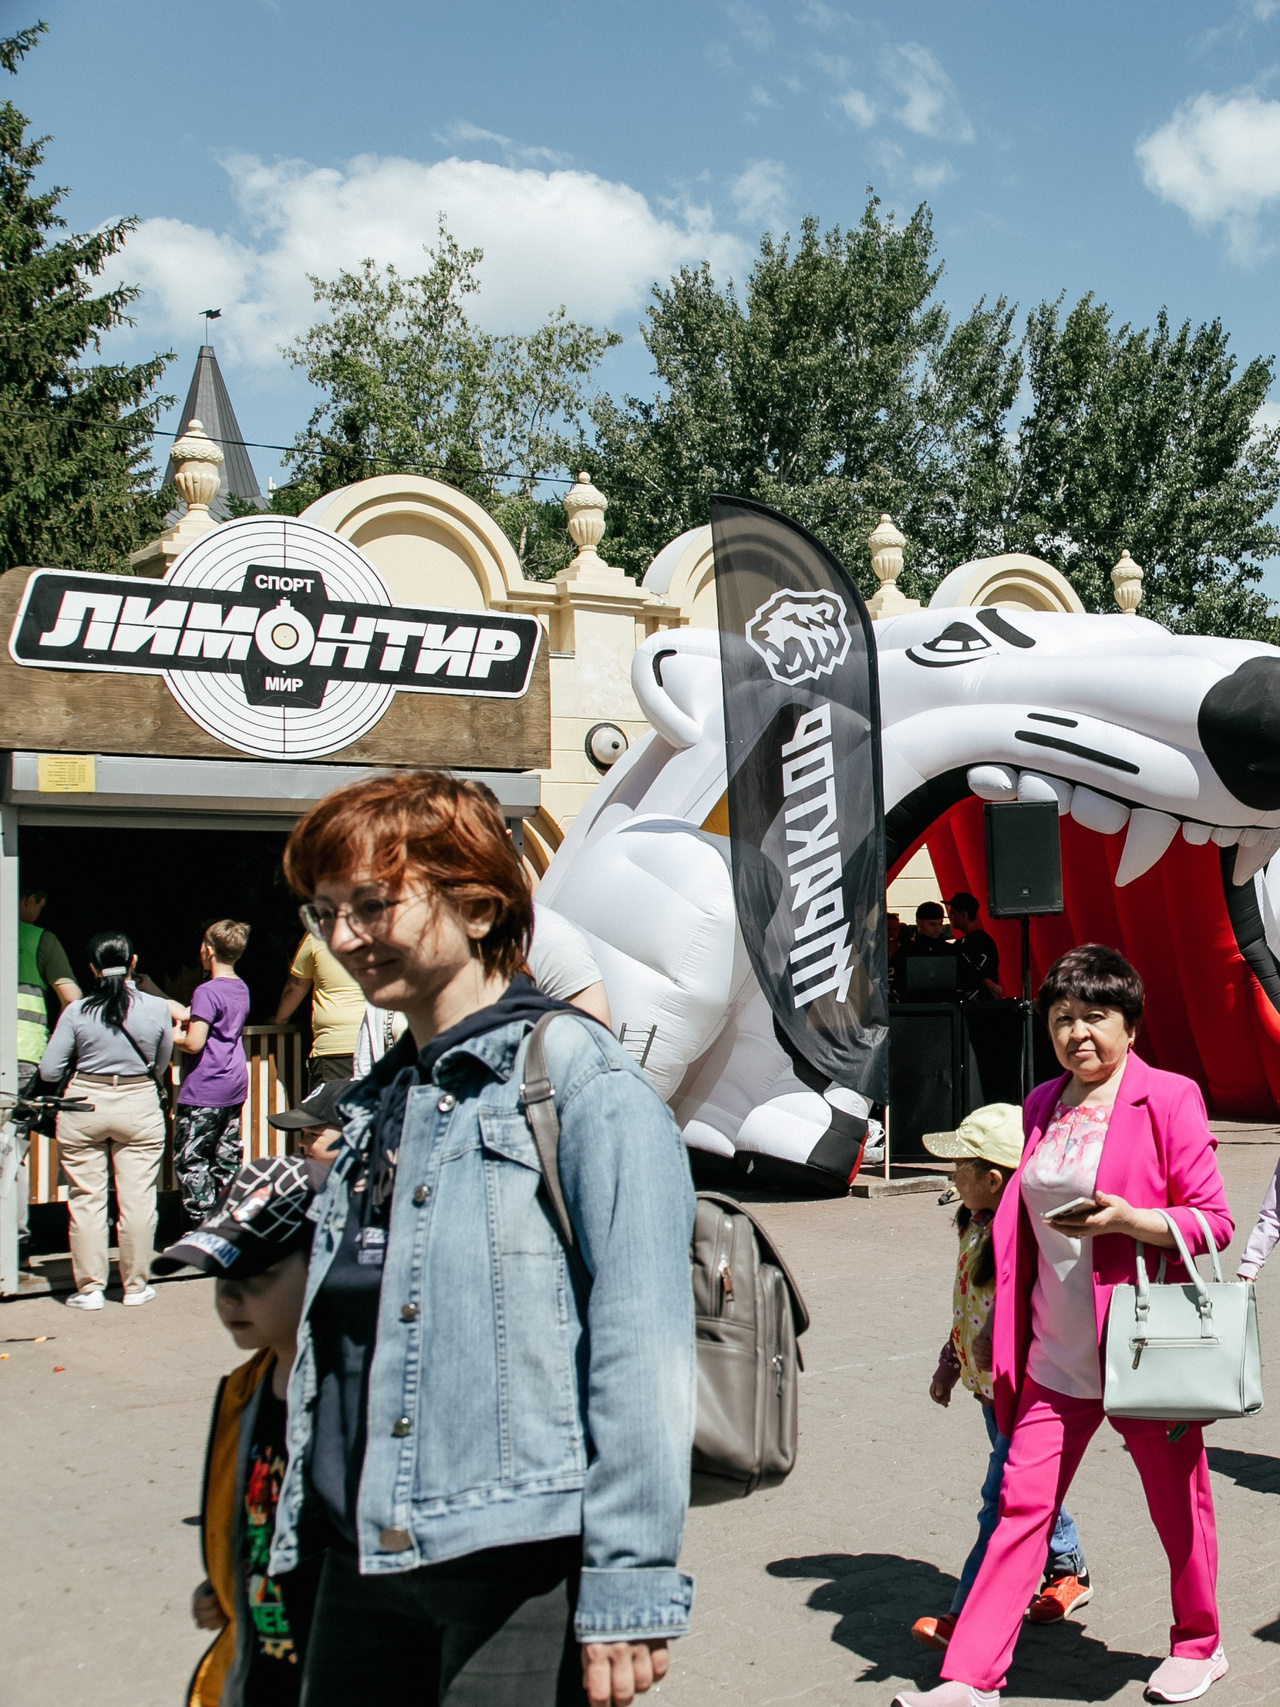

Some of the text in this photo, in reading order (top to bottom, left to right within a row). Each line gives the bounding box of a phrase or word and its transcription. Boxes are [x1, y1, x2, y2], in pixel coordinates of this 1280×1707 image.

[255, 574, 315, 594] СПОРТ
[39, 590, 522, 678] ЛИМОНТИР
[265, 676, 304, 693] МИР
